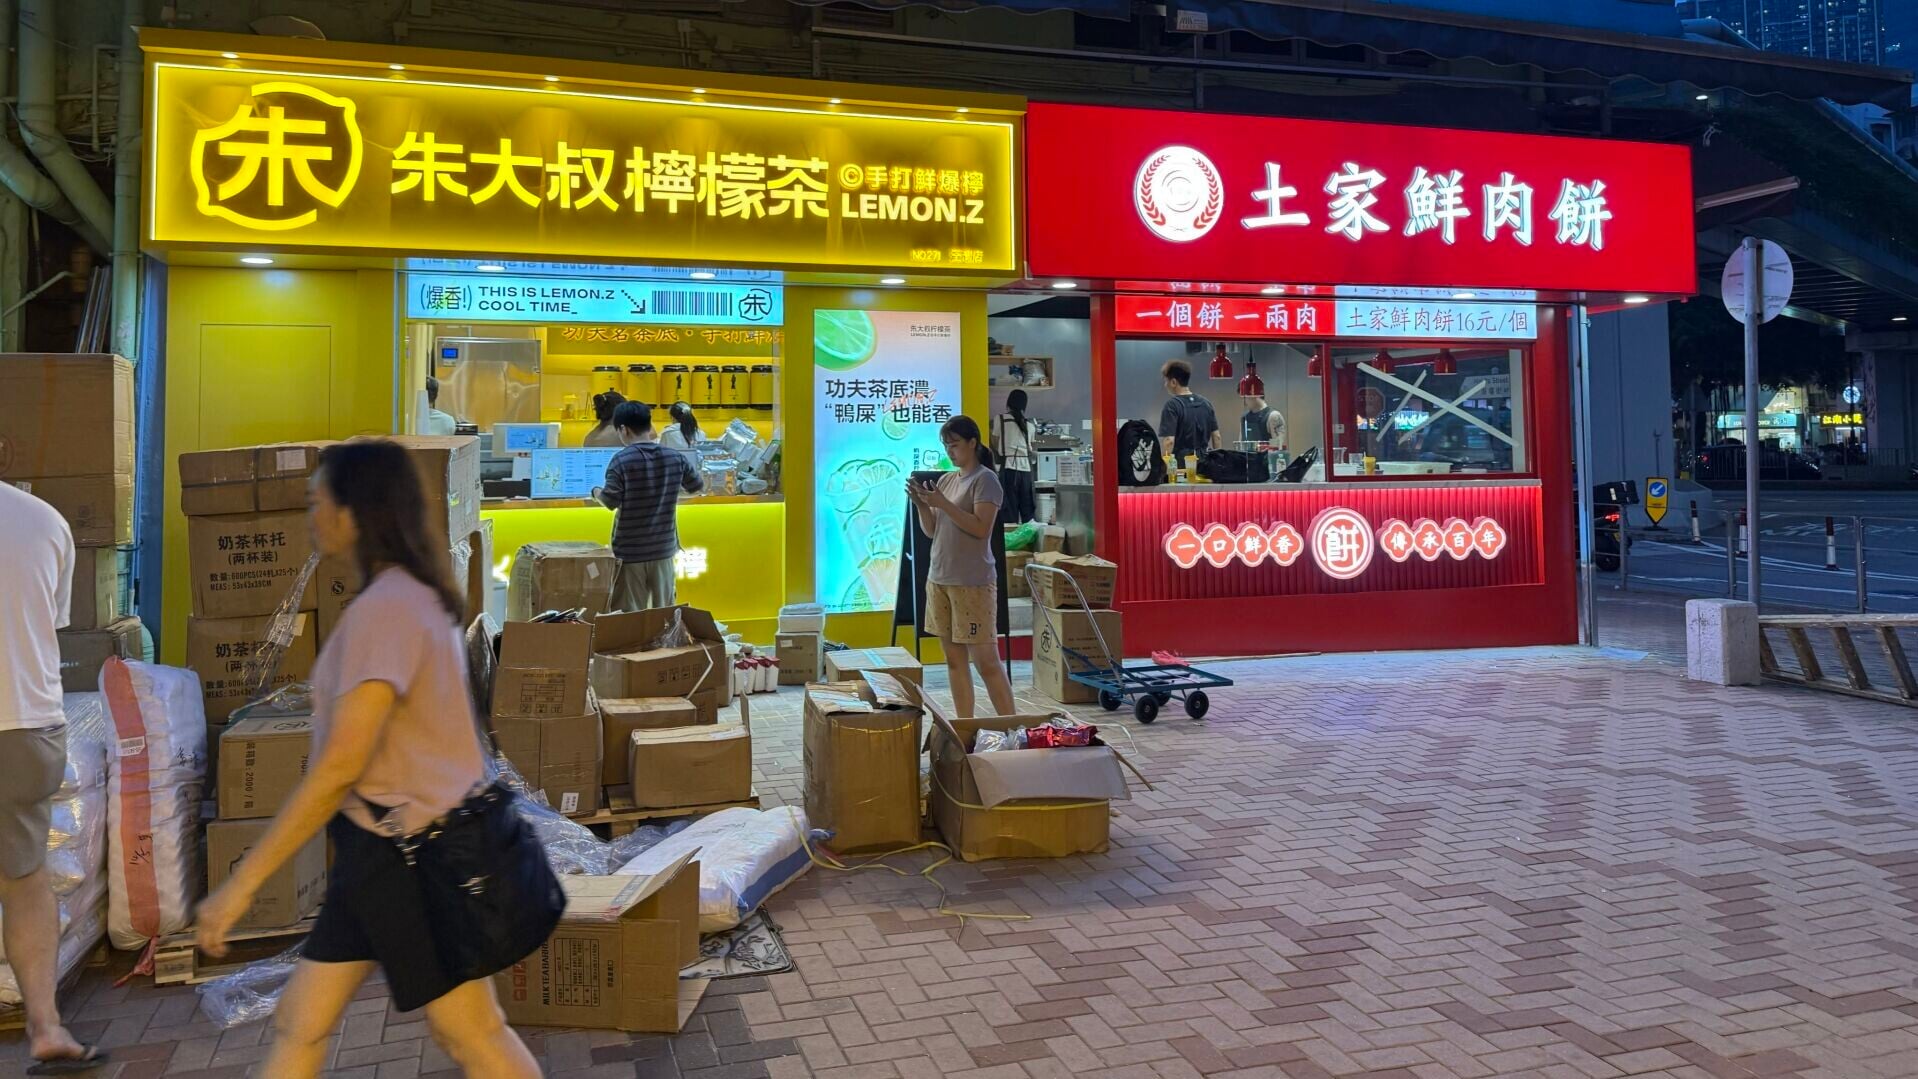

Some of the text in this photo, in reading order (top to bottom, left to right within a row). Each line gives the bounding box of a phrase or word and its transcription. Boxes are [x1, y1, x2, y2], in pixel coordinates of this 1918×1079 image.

[391, 131, 830, 220] 朱大叔檸檬茶
[841, 193, 985, 224] LEMON.Z
[1240, 162, 1613, 252] 土家鮮肉餅
[478, 285, 615, 300] THIS IS LEMON.Z
[478, 300, 525, 312] COOL
[218, 532, 286, 550] 奶茶杯托
[1178, 534, 1293, 554] 一口鮮香
[1323, 523, 1361, 566] 餅
[228, 551, 279, 566] (两杯装)
